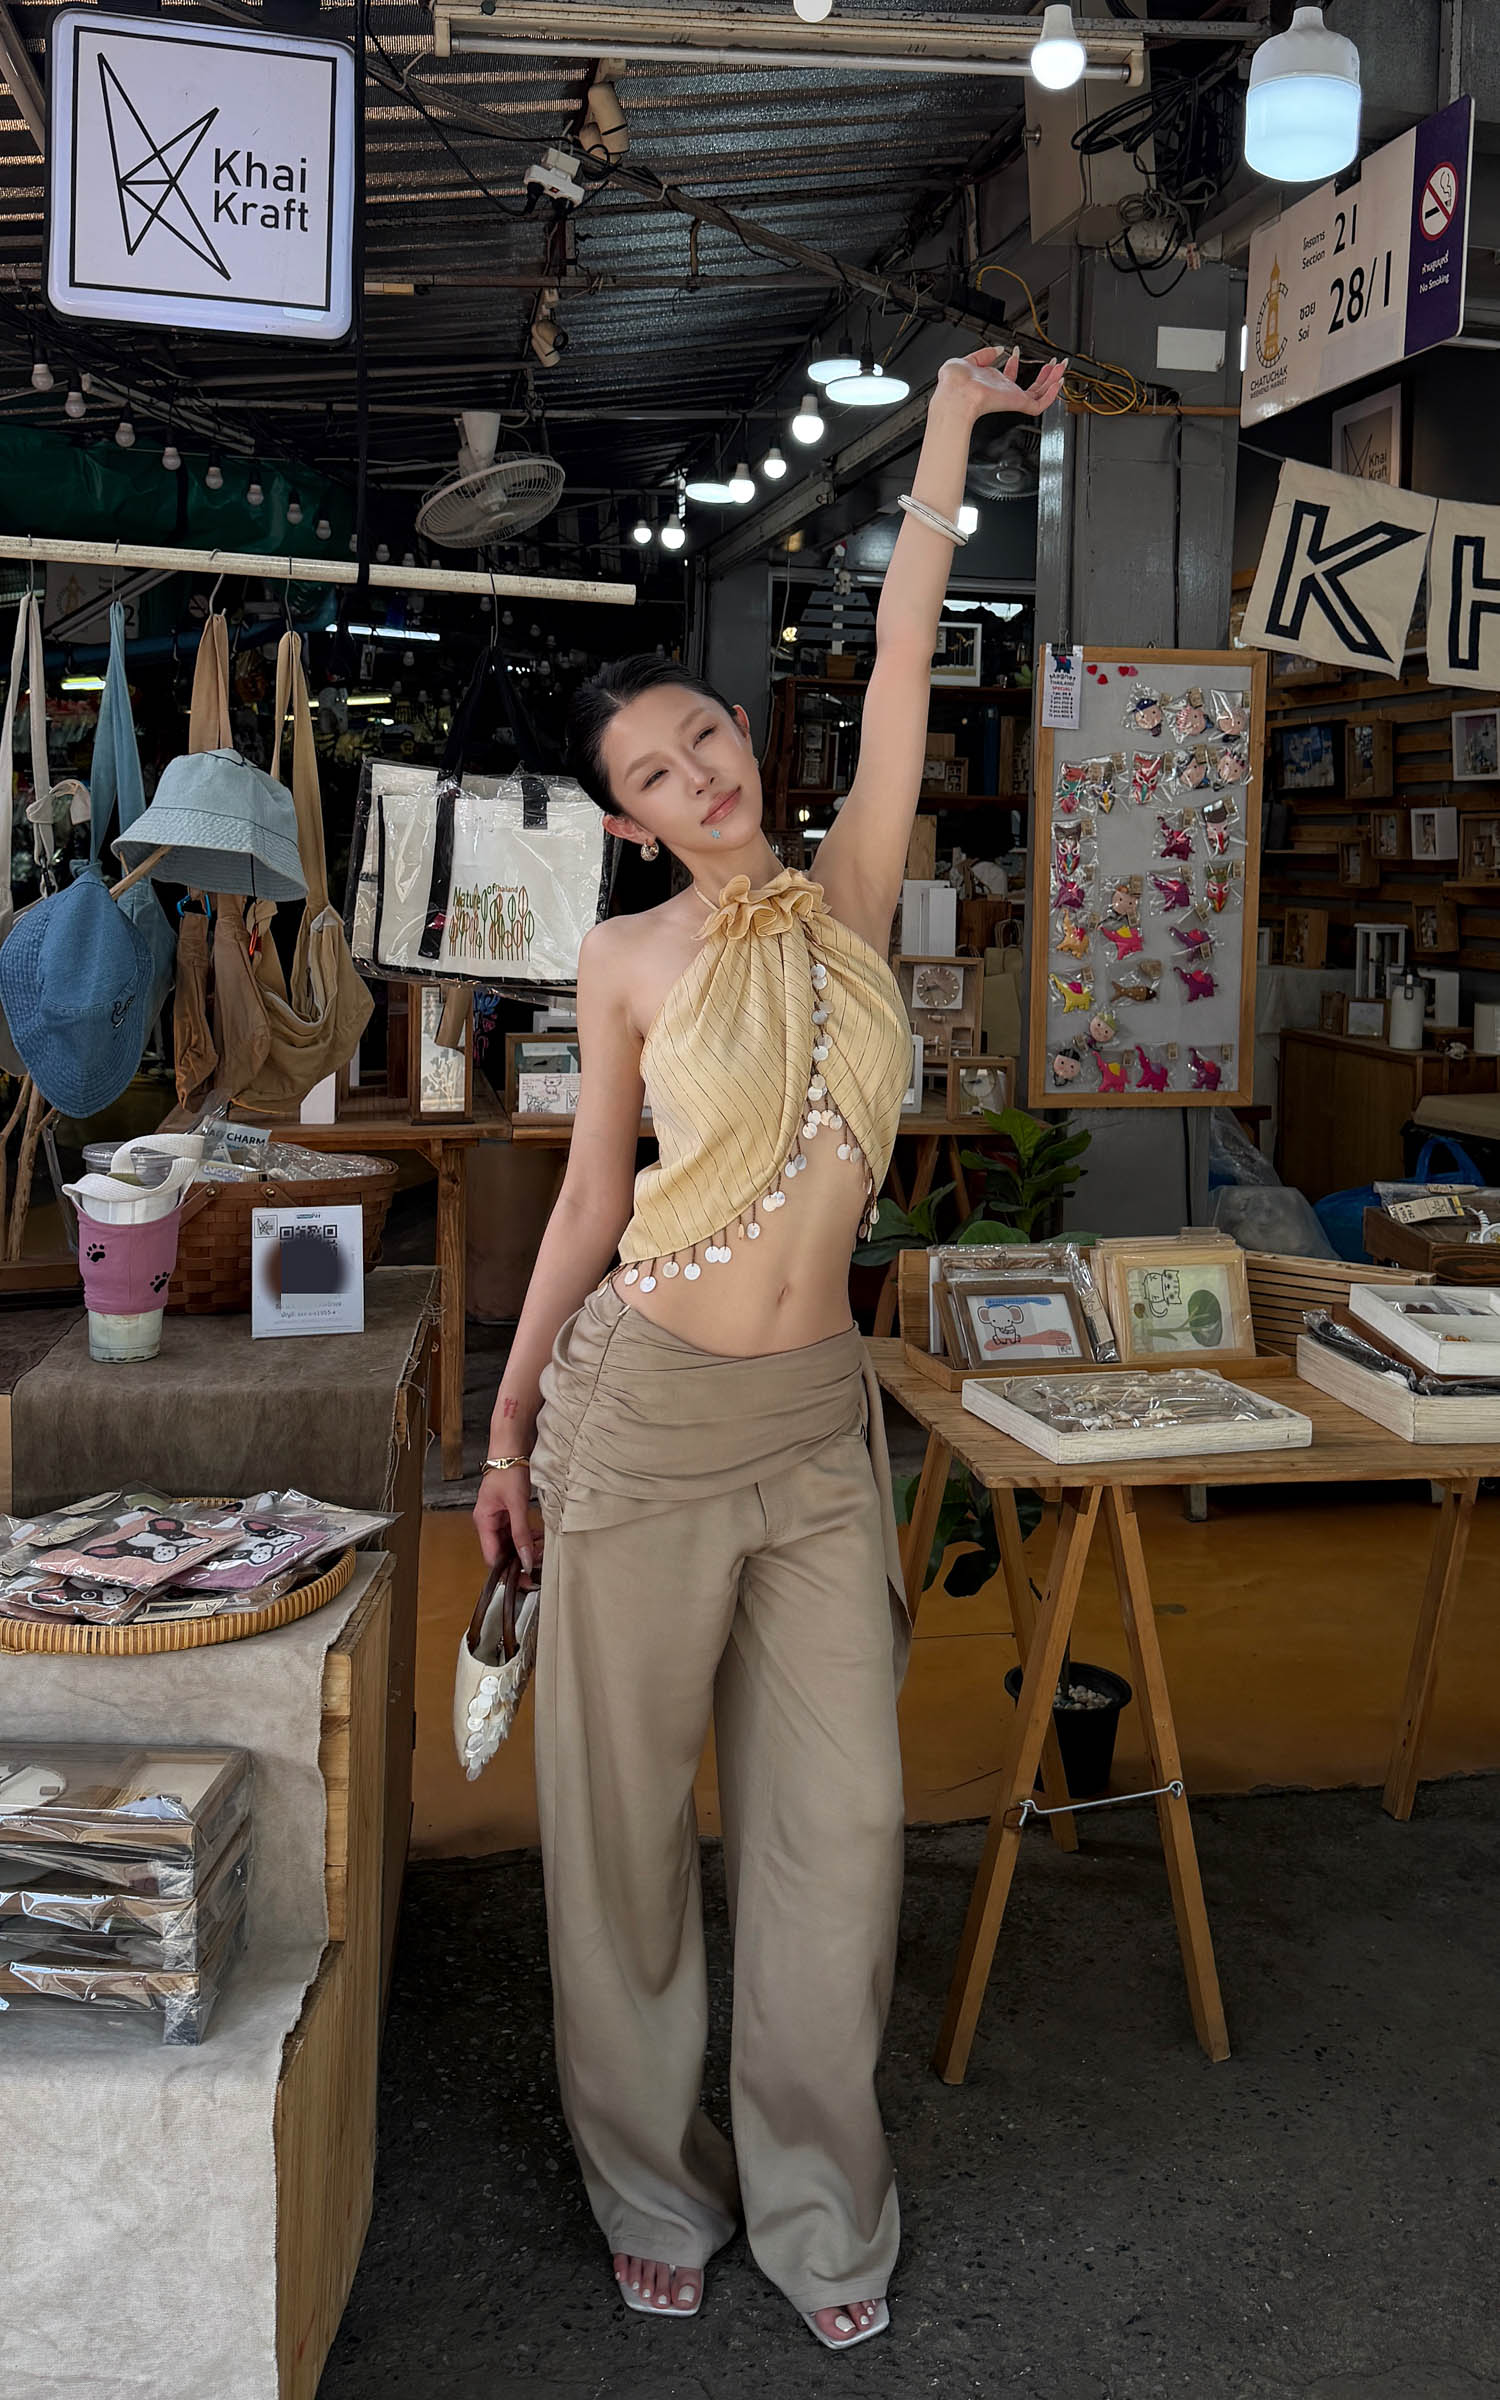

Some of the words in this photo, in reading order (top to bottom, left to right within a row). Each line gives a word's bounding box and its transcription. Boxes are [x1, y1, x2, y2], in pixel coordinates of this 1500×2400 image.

[214, 147, 307, 194] Khai
[213, 190, 309, 232] Kraft
[1333, 203, 1358, 256] 21
[1302, 250, 1326, 269] Section
[1328, 250, 1392, 335] 28/1
[1419, 282, 1429, 294] No
[1429, 273, 1450, 290] Smoking
[1299, 302, 1316, 321] ซอย
[1298, 324, 1310, 342] Soi
[1250, 364, 1288, 391] CHATUCHAK
[1368, 450, 1387, 468] Khai
[1368, 464, 1389, 481] Kraft
[453, 886, 481, 910] Nature
[486, 882, 497, 895] of
[226, 1132, 266, 1146] CHARM
